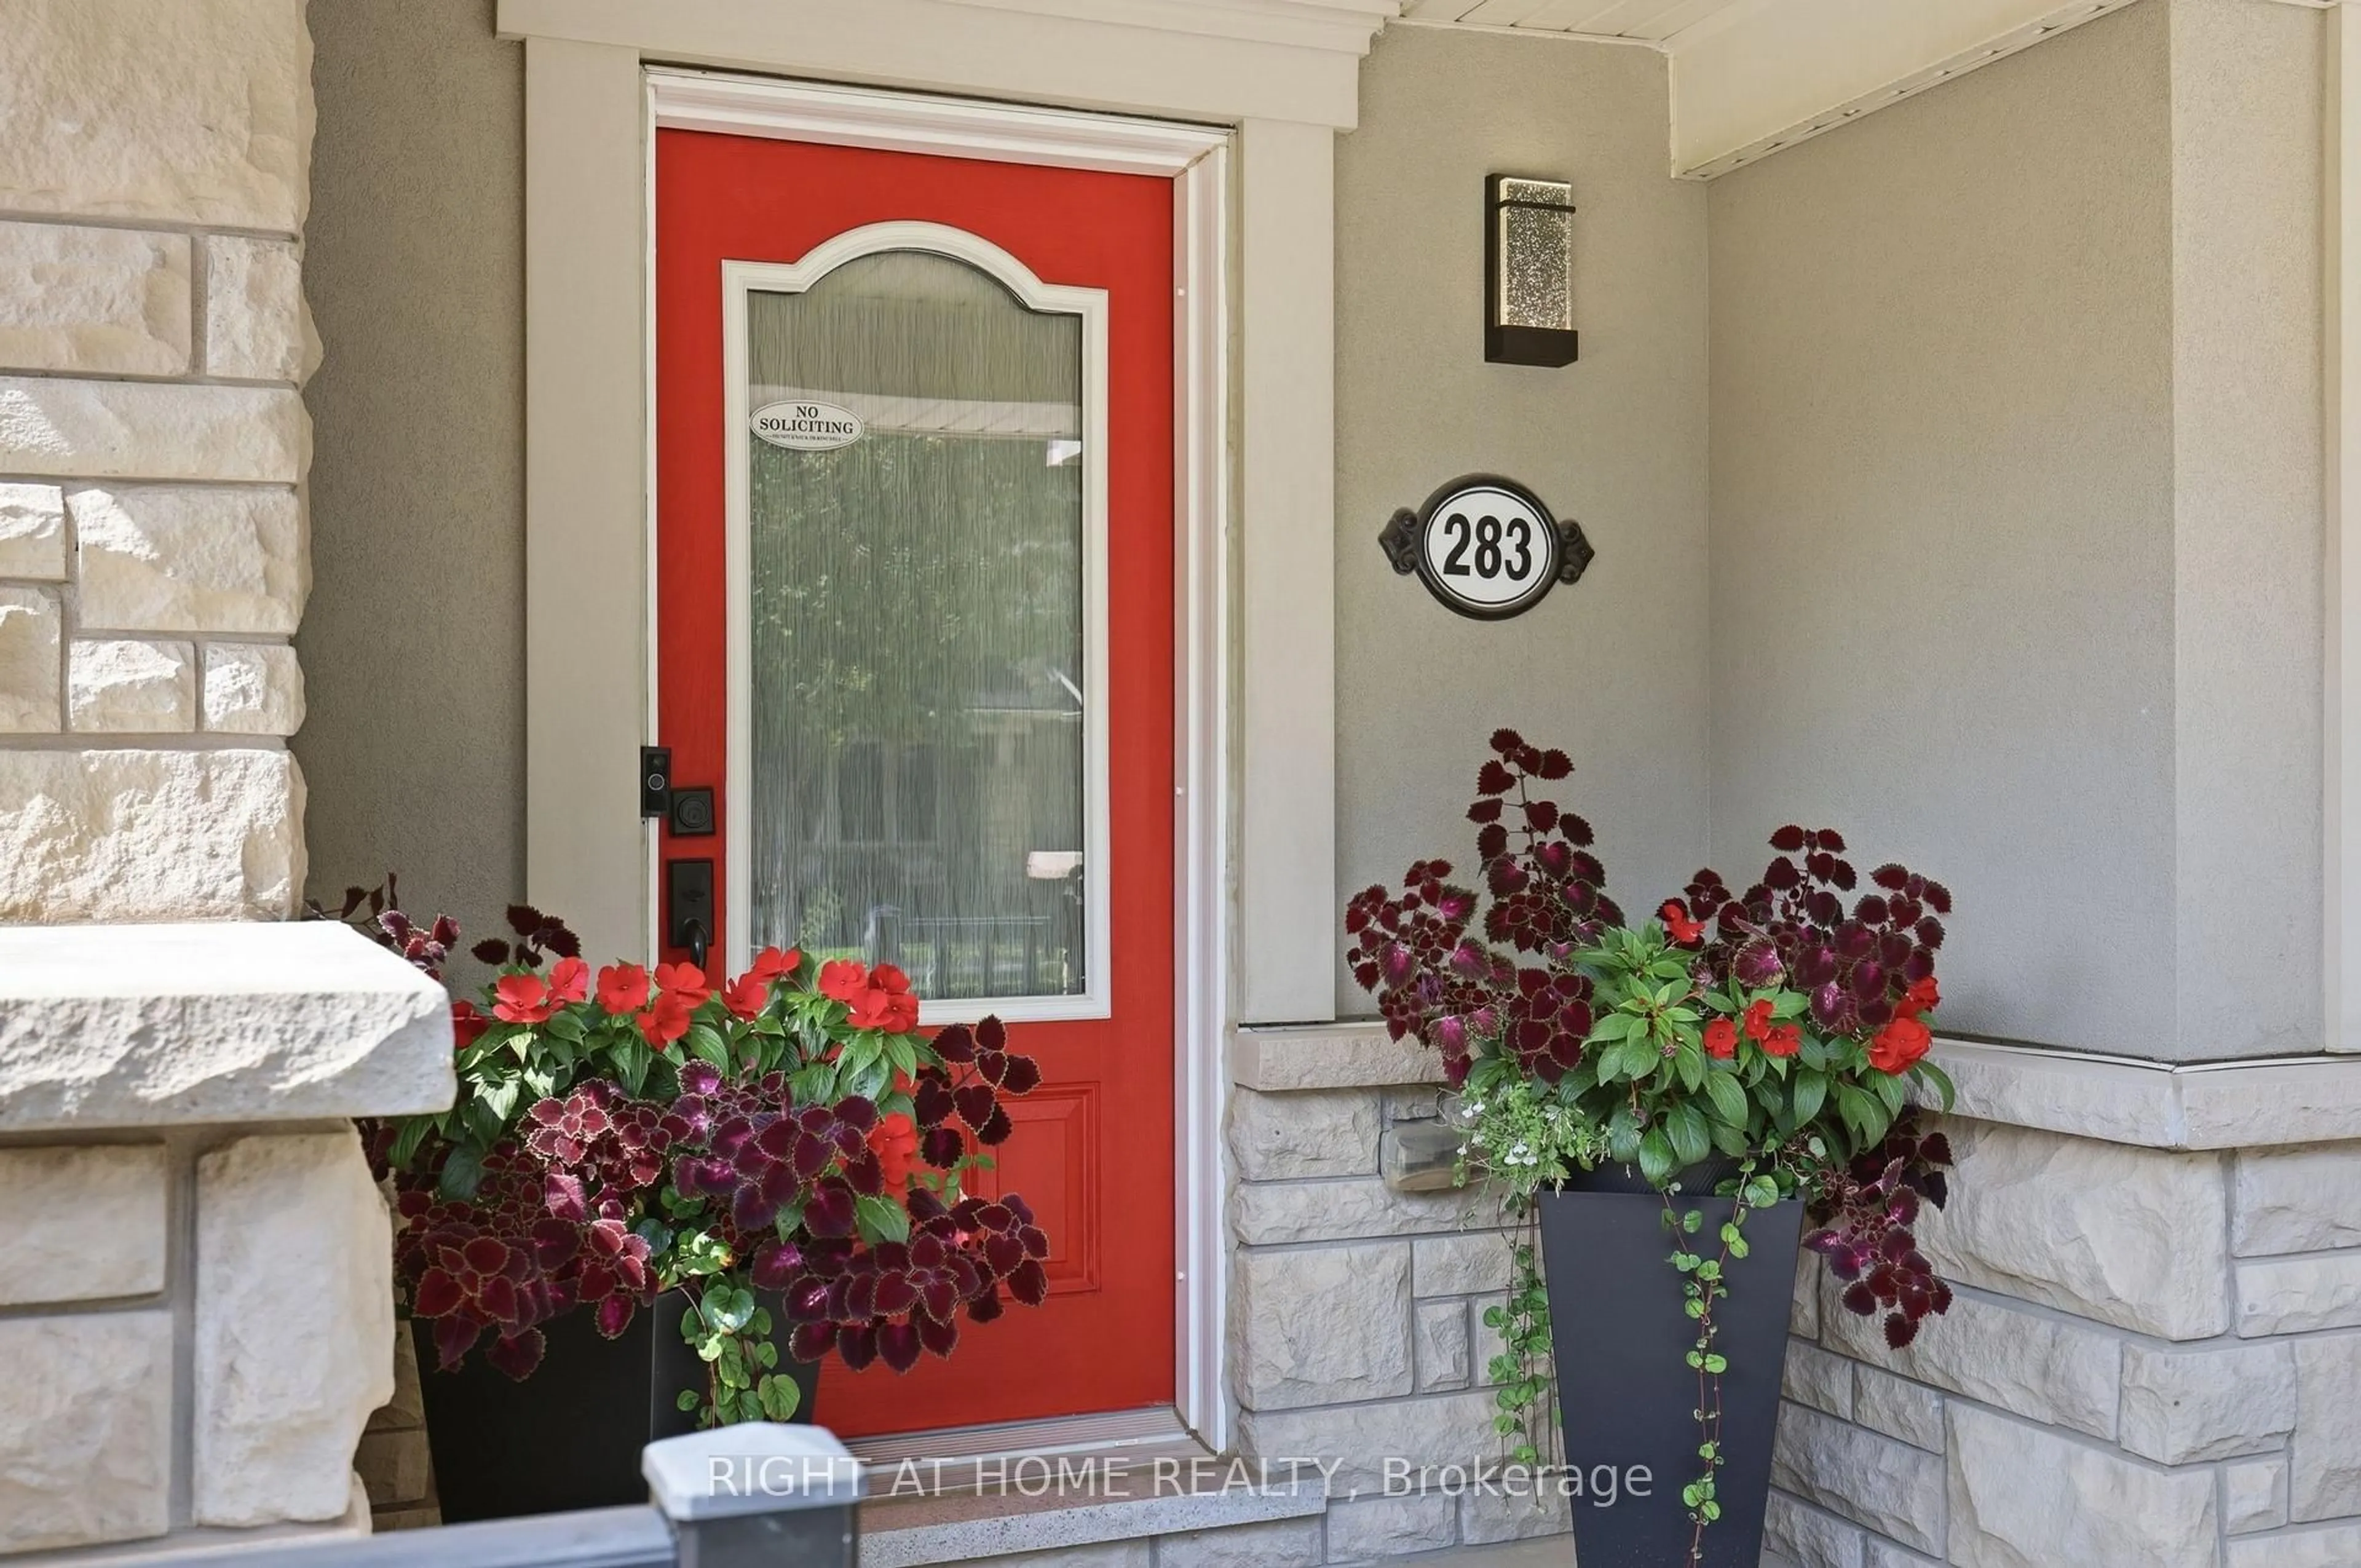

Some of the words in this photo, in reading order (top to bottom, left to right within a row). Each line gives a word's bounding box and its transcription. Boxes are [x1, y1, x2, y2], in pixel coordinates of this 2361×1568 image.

[796, 406, 818, 419] NO
[759, 418, 853, 434] SOLICITING
[1443, 513, 1532, 581] 283
